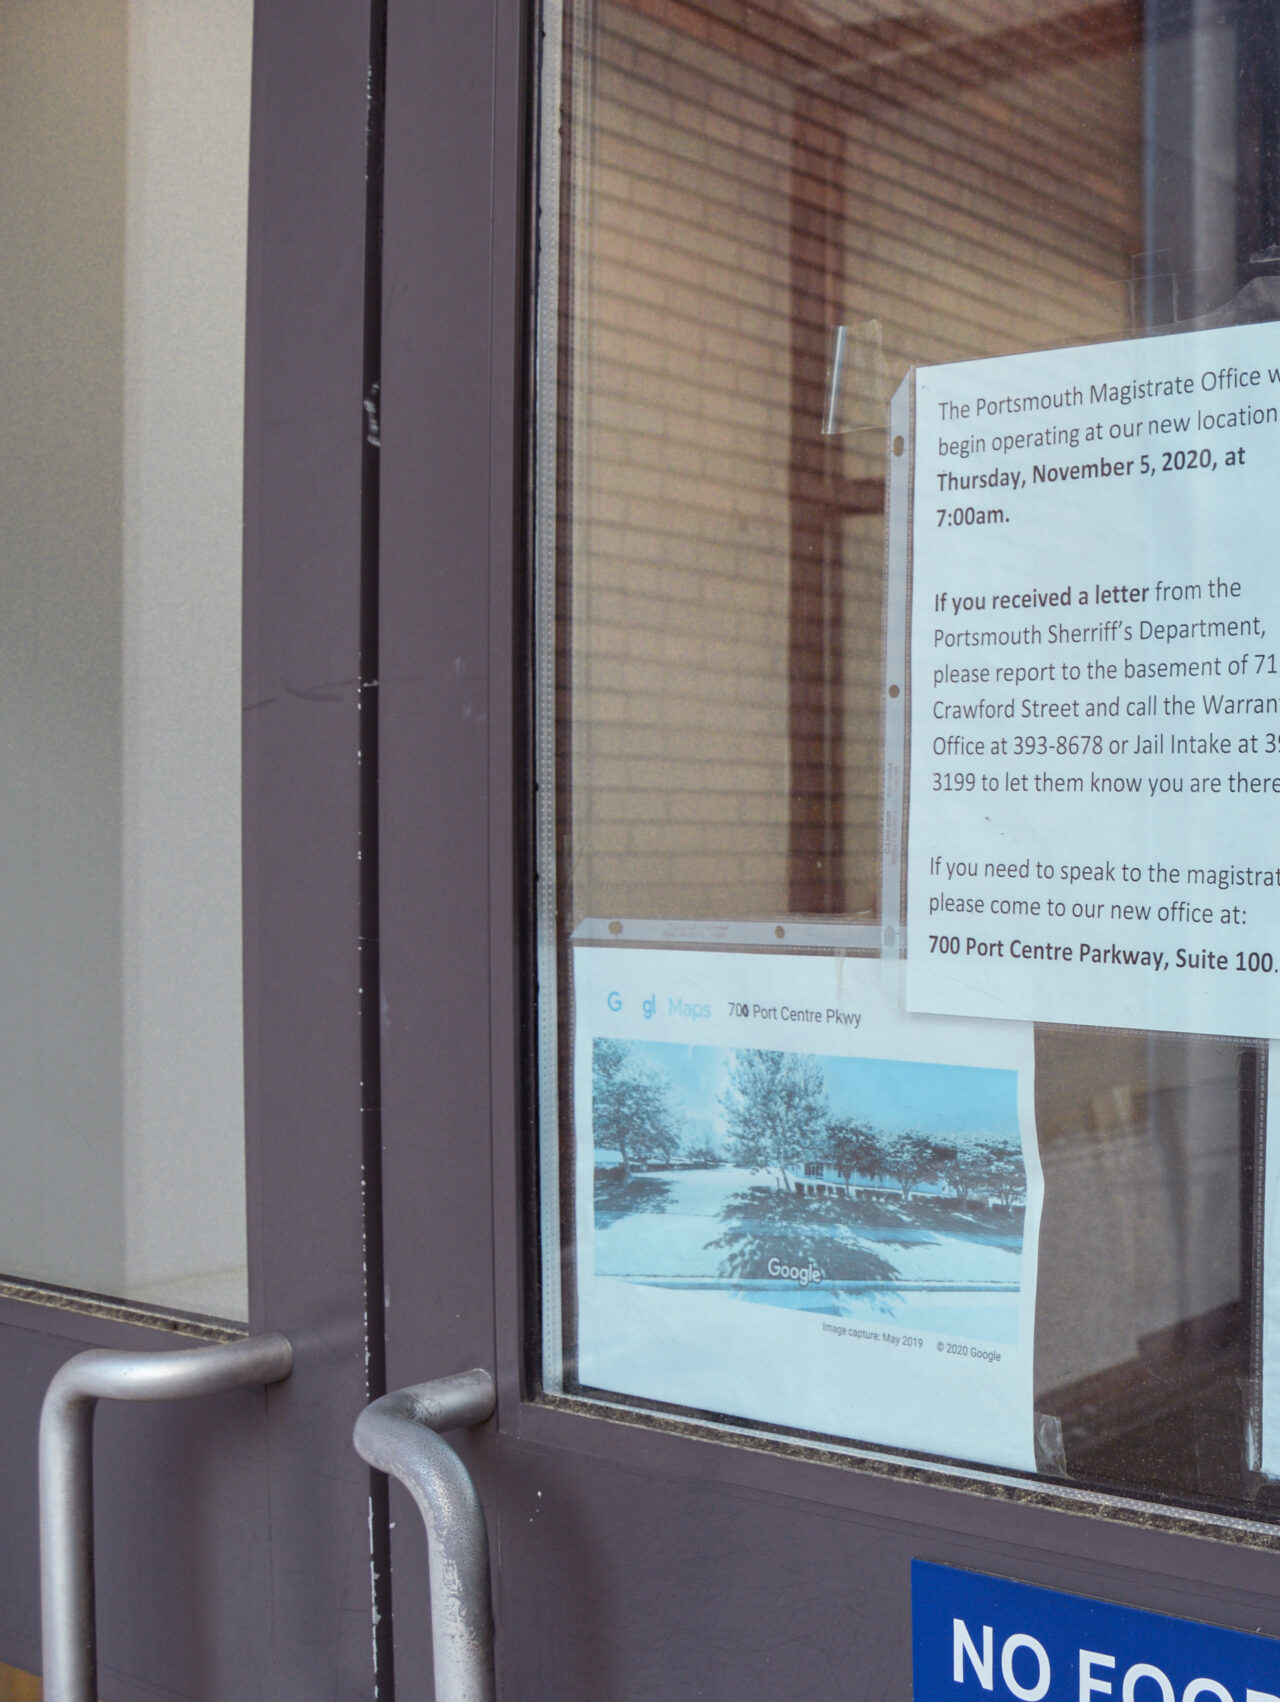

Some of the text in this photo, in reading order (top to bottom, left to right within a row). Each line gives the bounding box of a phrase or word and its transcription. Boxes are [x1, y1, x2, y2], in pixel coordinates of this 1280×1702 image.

[938, 401, 970, 421] The
[977, 386, 1083, 416] Portsmouth
[1091, 377, 1194, 405] Magistrate
[1201, 368, 1260, 391] Office
[939, 435, 985, 458] begin
[992, 426, 1080, 454] operating
[1086, 423, 1103, 441] at
[1110, 422, 1143, 438] our
[1149, 417, 1190, 435] new
[1198, 405, 1277, 430] location
[937, 447, 1245, 491] Thursday, November 5, 2020, at
[937, 507, 1009, 527] 7:00am.
[935, 577, 1241, 616] If you received a letter from the
[935, 624, 1041, 647] Portsmouth
[1140, 617, 1265, 644] Department,
[934, 664, 989, 688] please
[996, 664, 1055, 686] report
[1061, 663, 1080, 680] to
[1087, 659, 1117, 679] the
[1125, 658, 1221, 678] basement
[1228, 654, 1249, 675] of
[933, 698, 1014, 719] Crawford
[1021, 699, 1079, 718] Street
[1086, 696, 1119, 717] and
[1127, 695, 1156, 716] call
[1164, 695, 1195, 715] the
[933, 736, 985, 755] Office
[991, 738, 1007, 755] at
[1014, 736, 1102, 755] 393-8678
[1109, 740, 1128, 754] or
[1134, 733, 1163, 754] Jail
[1172, 732, 1231, 754] Intake
[1239, 735, 1258, 753] at
[933, 773, 975, 791] 3199
[981, 774, 999, 791] to
[1006, 772, 1028, 791] let
[1034, 772, 1083, 792] them
[1091, 772, 1142, 792] know
[1148, 778, 1183, 797] you
[1190, 778, 1221, 792] are
[931, 856, 942, 875] If
[946, 862, 977, 880] you
[985, 859, 1029, 878] need
[1036, 862, 1054, 879] to
[1061, 861, 1115, 884] speak
[1121, 864, 1141, 882] to
[1148, 862, 1180, 883] the
[930, 892, 1246, 924] please come to our new office at:
[929, 935, 1278, 973] 700 Port Centre Parkway, Suite 100.
[669, 997, 712, 1022] Maps
[753, 1004, 777, 1020] Port
[781, 1006, 822, 1023] Centre
[826, 1009, 861, 1029] Pkwy
[768, 1257, 821, 1286] Google
[823, 1323, 847, 1336] Image
[848, 1328, 880, 1341] capture:
[882, 1332, 900, 1347] May
[902, 1335, 923, 1348] 2019
[946, 1343, 968, 1356] 2020
[970, 1347, 1001, 1362] Google
[952, 1617, 1051, 1702] NO
